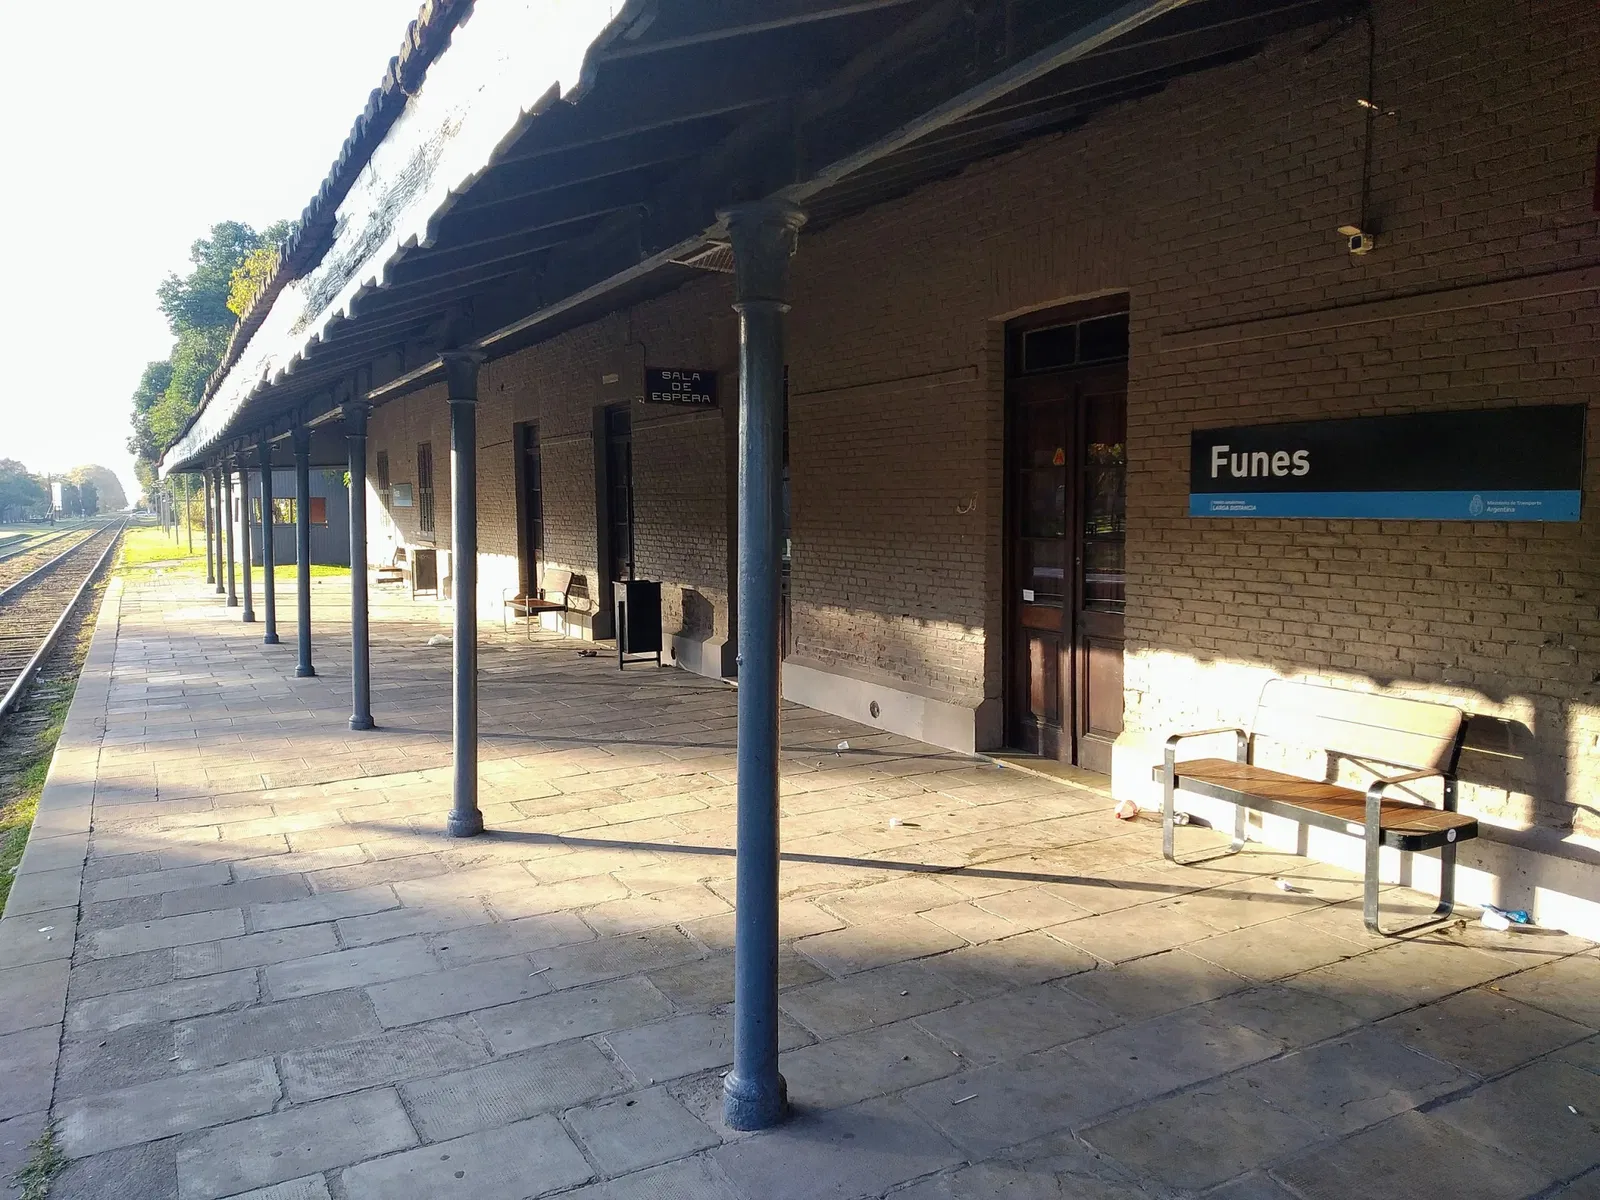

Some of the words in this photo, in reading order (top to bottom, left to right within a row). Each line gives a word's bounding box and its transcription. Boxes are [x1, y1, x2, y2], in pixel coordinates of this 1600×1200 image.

[662, 371, 700, 381] SALA
[671, 382, 692, 391] DE
[652, 392, 711, 403] ESPERA
[1211, 445, 1310, 478] Funes
